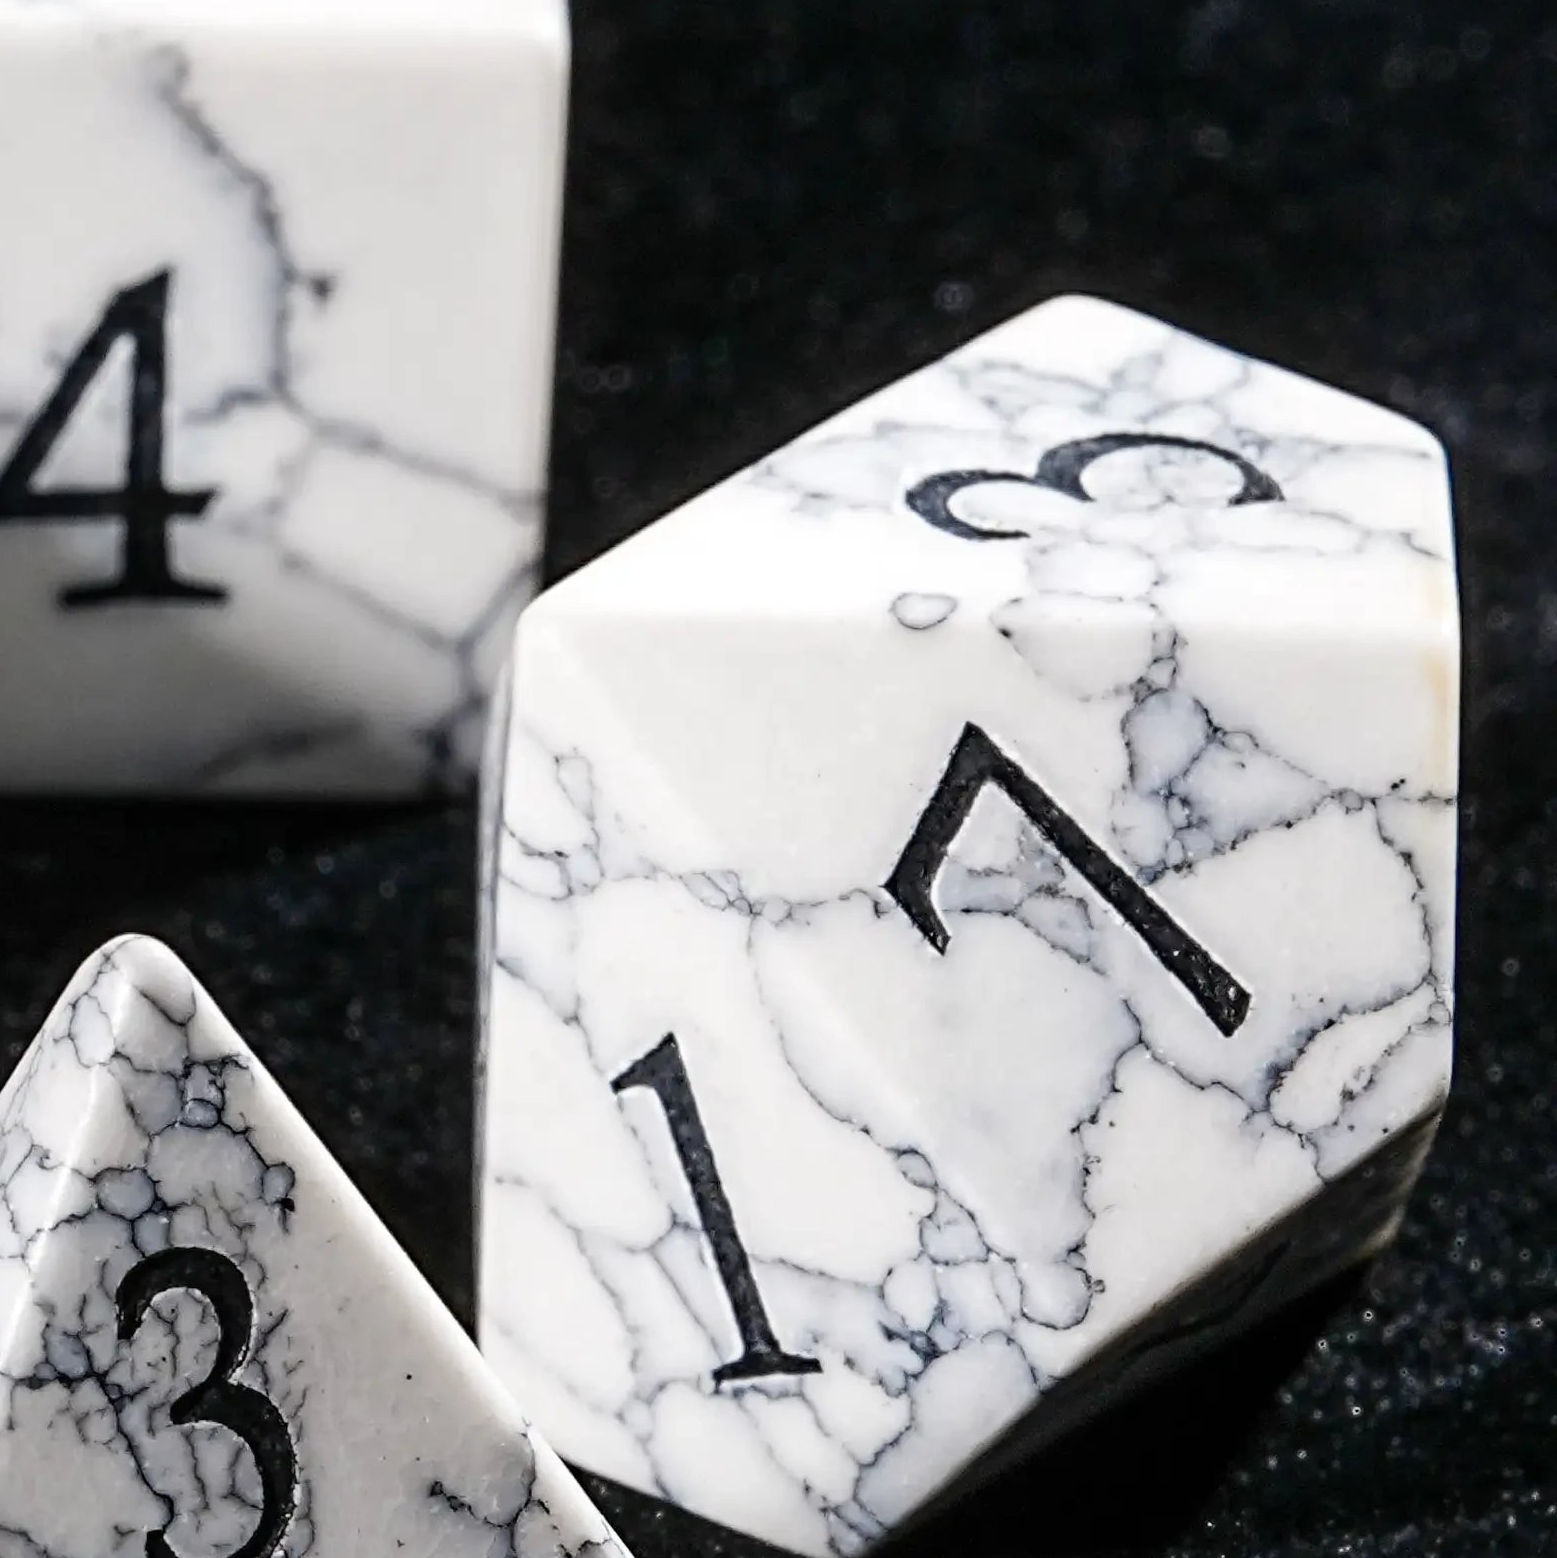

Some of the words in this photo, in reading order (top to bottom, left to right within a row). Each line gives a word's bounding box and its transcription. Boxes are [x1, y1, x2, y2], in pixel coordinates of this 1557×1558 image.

[903, 430, 1286, 541] 3
[880, 720, 1253, 1040] 7
[609, 1029, 825, 1396] 1
